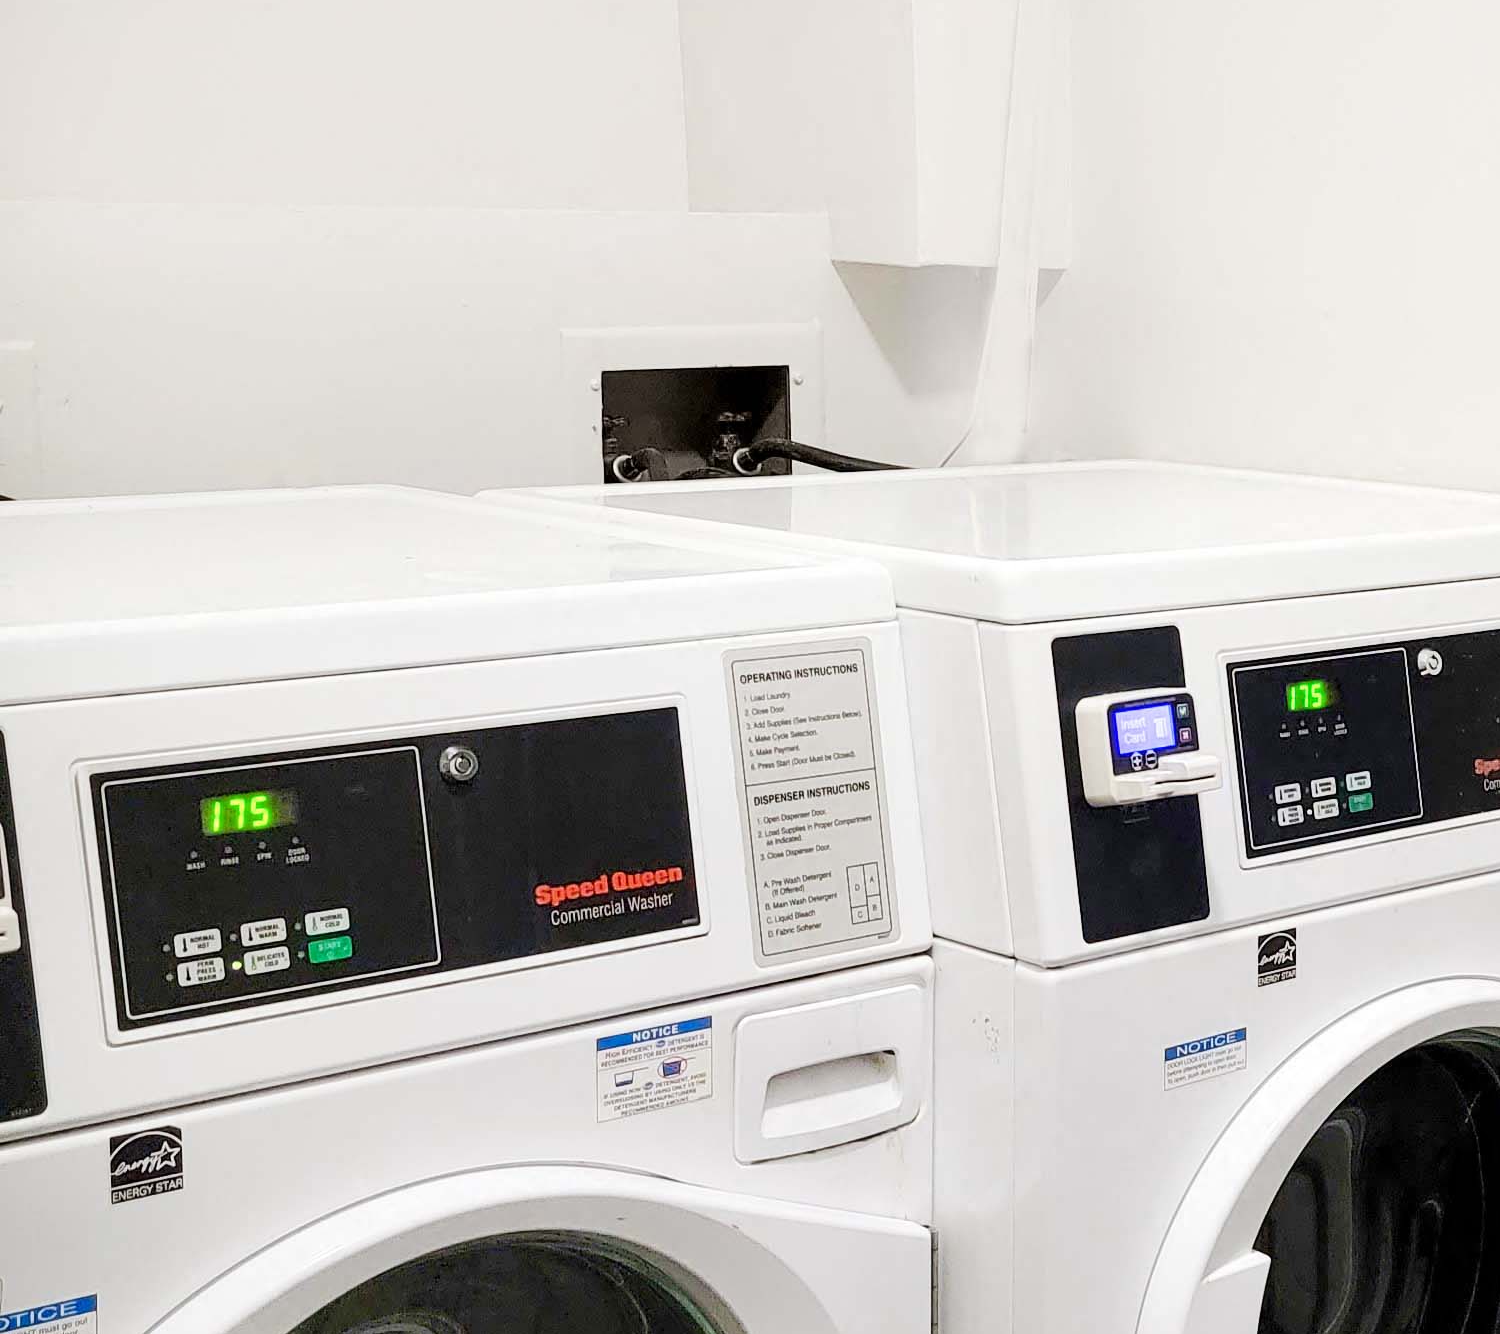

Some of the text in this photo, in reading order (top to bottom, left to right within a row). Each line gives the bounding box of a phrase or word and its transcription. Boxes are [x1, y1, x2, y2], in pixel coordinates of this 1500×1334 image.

[740, 663, 858, 684] OPERATING INSTRUCTIONS
[751, 693, 765, 701] Load
[1291, 683, 1323, 710] 175
[1121, 717, 1146, 729] Insert
[1125, 731, 1146, 744] Card
[754, 781, 870, 806] DISPENSER INSTRUCTIONS
[213, 795, 269, 832] 175
[763, 816, 780, 824] Open
[781, 810, 810, 821] Dispenser
[765, 828, 780, 837] Load
[813, 821, 833, 829] Proper
[834, 815, 872, 827] Compartment
[767, 852, 784, 860] Close
[785, 847, 814, 858] Dispenser
[534, 867, 683, 906] Speed Queen
[771, 879, 782, 887] Pre
[784, 876, 801, 884] Wash
[802, 871, 831, 882] Detergent
[551, 893, 673, 925] Commercial Washer
[773, 901, 787, 909] Main
[789, 898, 806, 906] Wash
[808, 893, 837, 903] Detergent
[774, 914, 793, 923] Liquid
[795, 909, 815, 918] Bleach
[255, 924, 279, 933] NORMAL
[776, 922, 822, 936] Fabric Softener
[1259, 973, 1280, 985] ENERGY
[632, 1025, 679, 1042] NOTICE
[1176, 1032, 1237, 1056] NOTICE
[112, 1177, 183, 1203] ENERGY STAR
[38, 1323, 60, 1334] must
[61, 1321, 74, 1332] go
